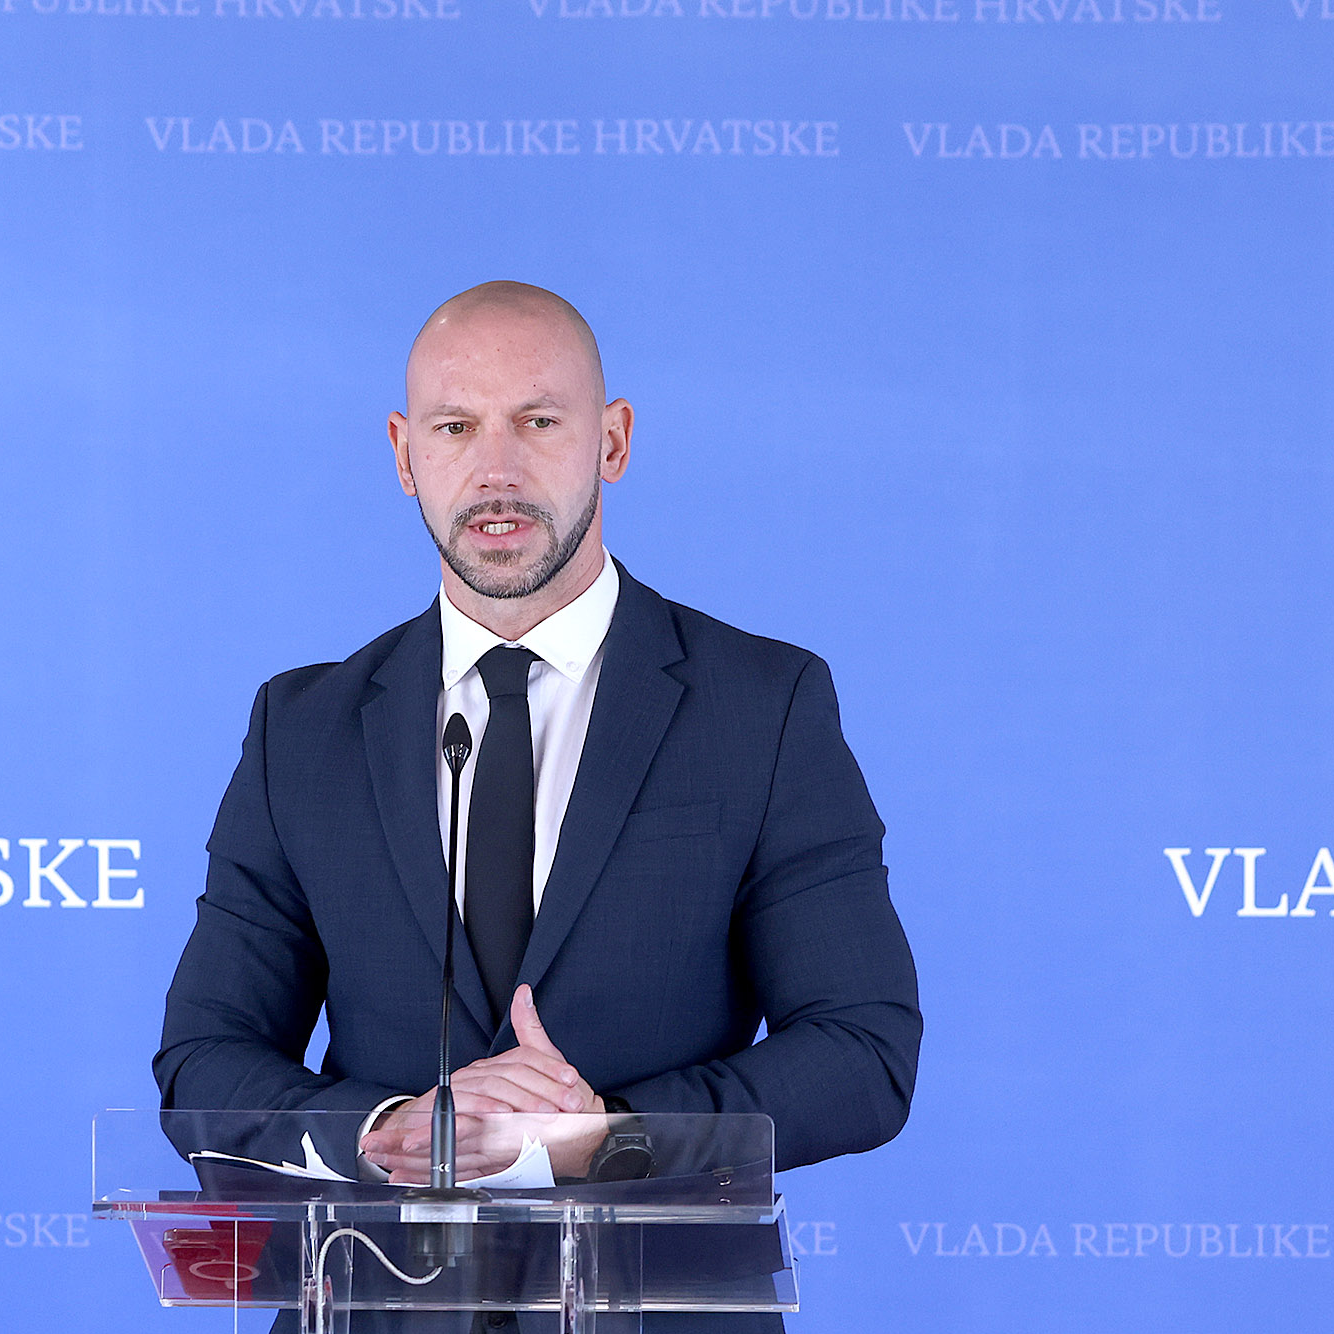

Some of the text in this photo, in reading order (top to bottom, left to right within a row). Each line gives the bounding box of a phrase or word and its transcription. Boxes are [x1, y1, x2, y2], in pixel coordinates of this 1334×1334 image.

[144, 116, 840, 157] VLADA REPUBLIKE HRVATSKE
[901, 122, 1063, 159] VLADA
[898, 1221, 1059, 1258] VLADA
[1070, 1222, 1332, 1259] REPUBLIKE
